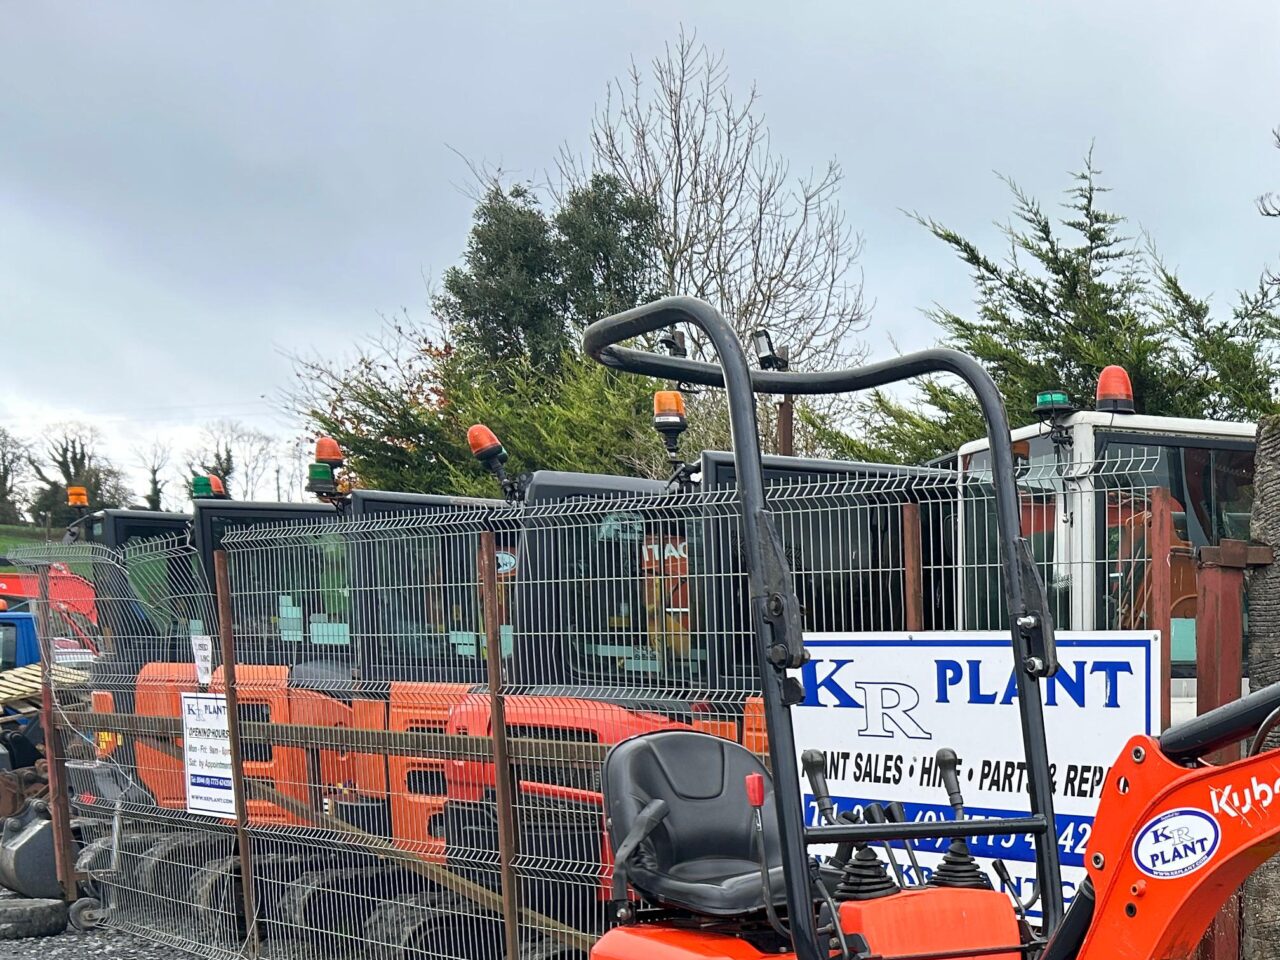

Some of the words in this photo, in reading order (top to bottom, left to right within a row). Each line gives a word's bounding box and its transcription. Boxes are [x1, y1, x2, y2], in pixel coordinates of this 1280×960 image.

[796, 658, 932, 740] KR
[853, 752, 903, 785] SALES
[919, 756, 962, 788] HIE
[979, 759, 1030, 793] PART
[1150, 837, 1209, 869] PLANT
[1151, 825, 1195, 847] KR
